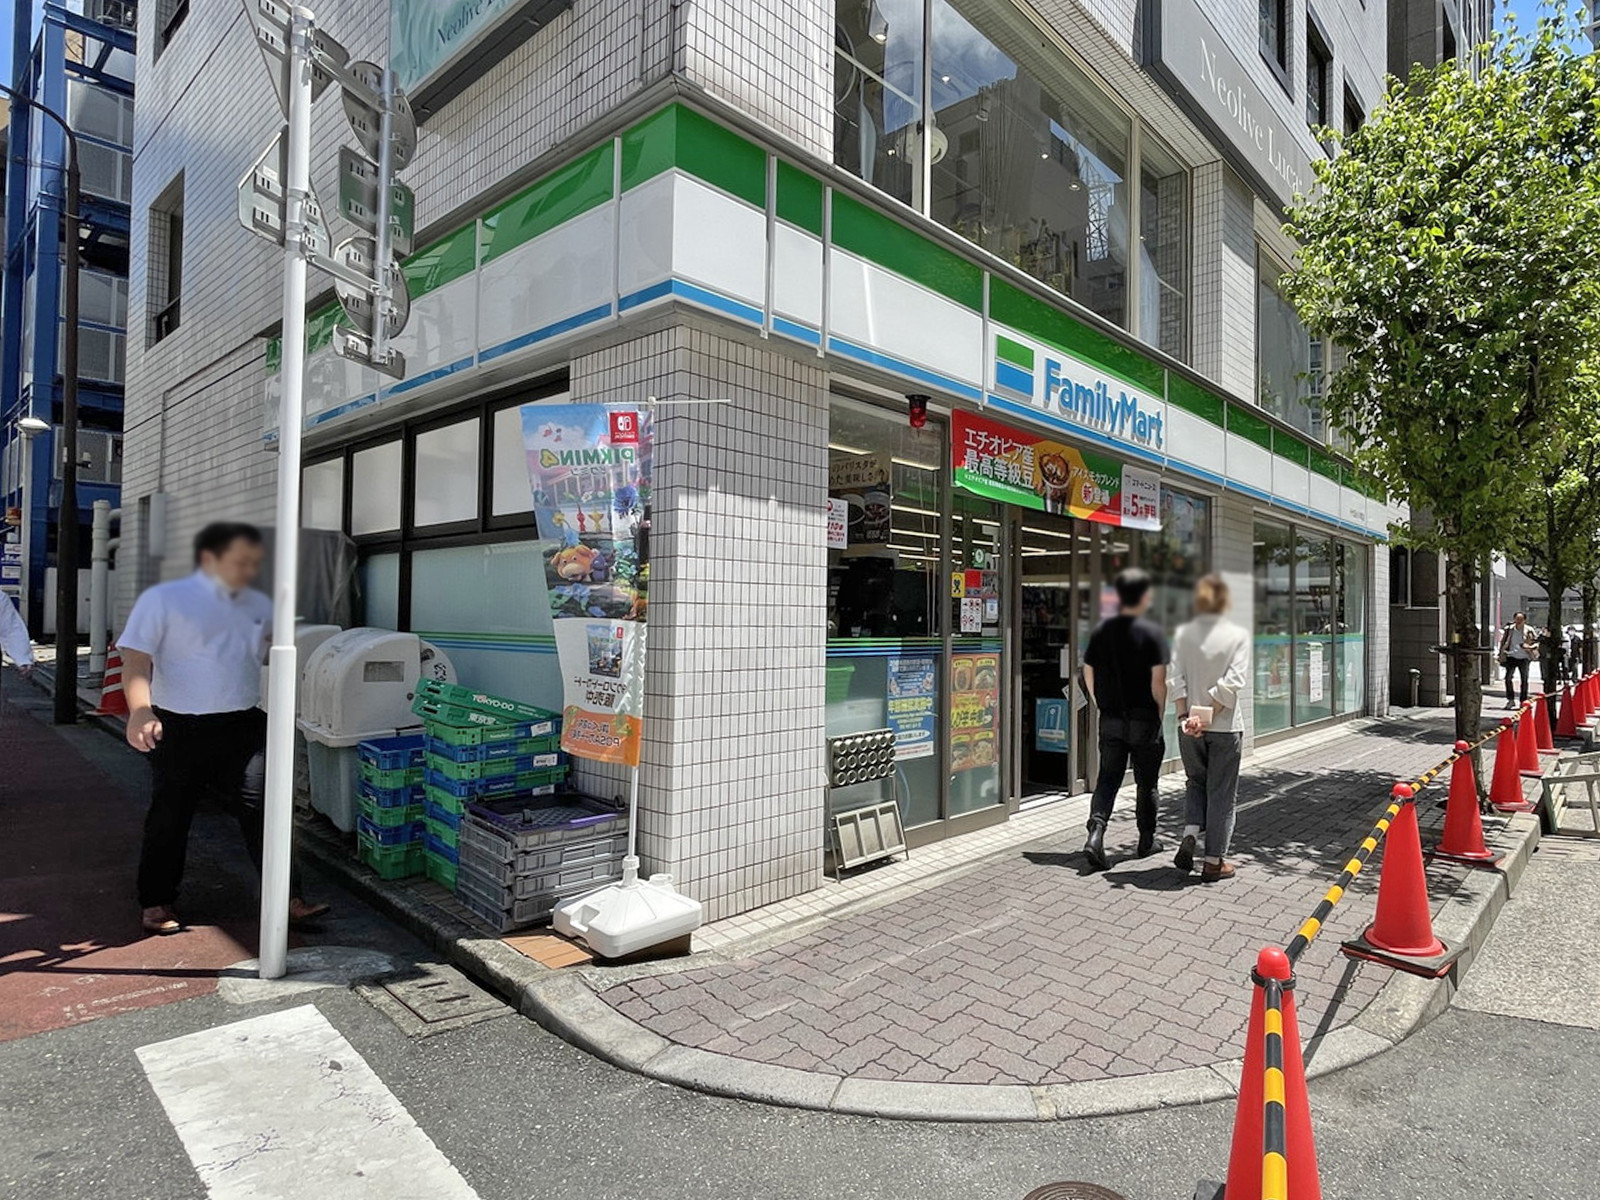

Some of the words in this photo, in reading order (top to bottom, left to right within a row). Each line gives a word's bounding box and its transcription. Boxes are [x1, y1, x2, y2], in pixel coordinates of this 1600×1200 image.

[1200, 37, 1264, 151] Neolive
[1044, 357, 1163, 447] FamilyMart
[964, 428, 1034, 465] エチオピア産
[963, 448, 1035, 489] 最高等級豆
[1071, 466, 1120, 488] アイスモカブレンド
